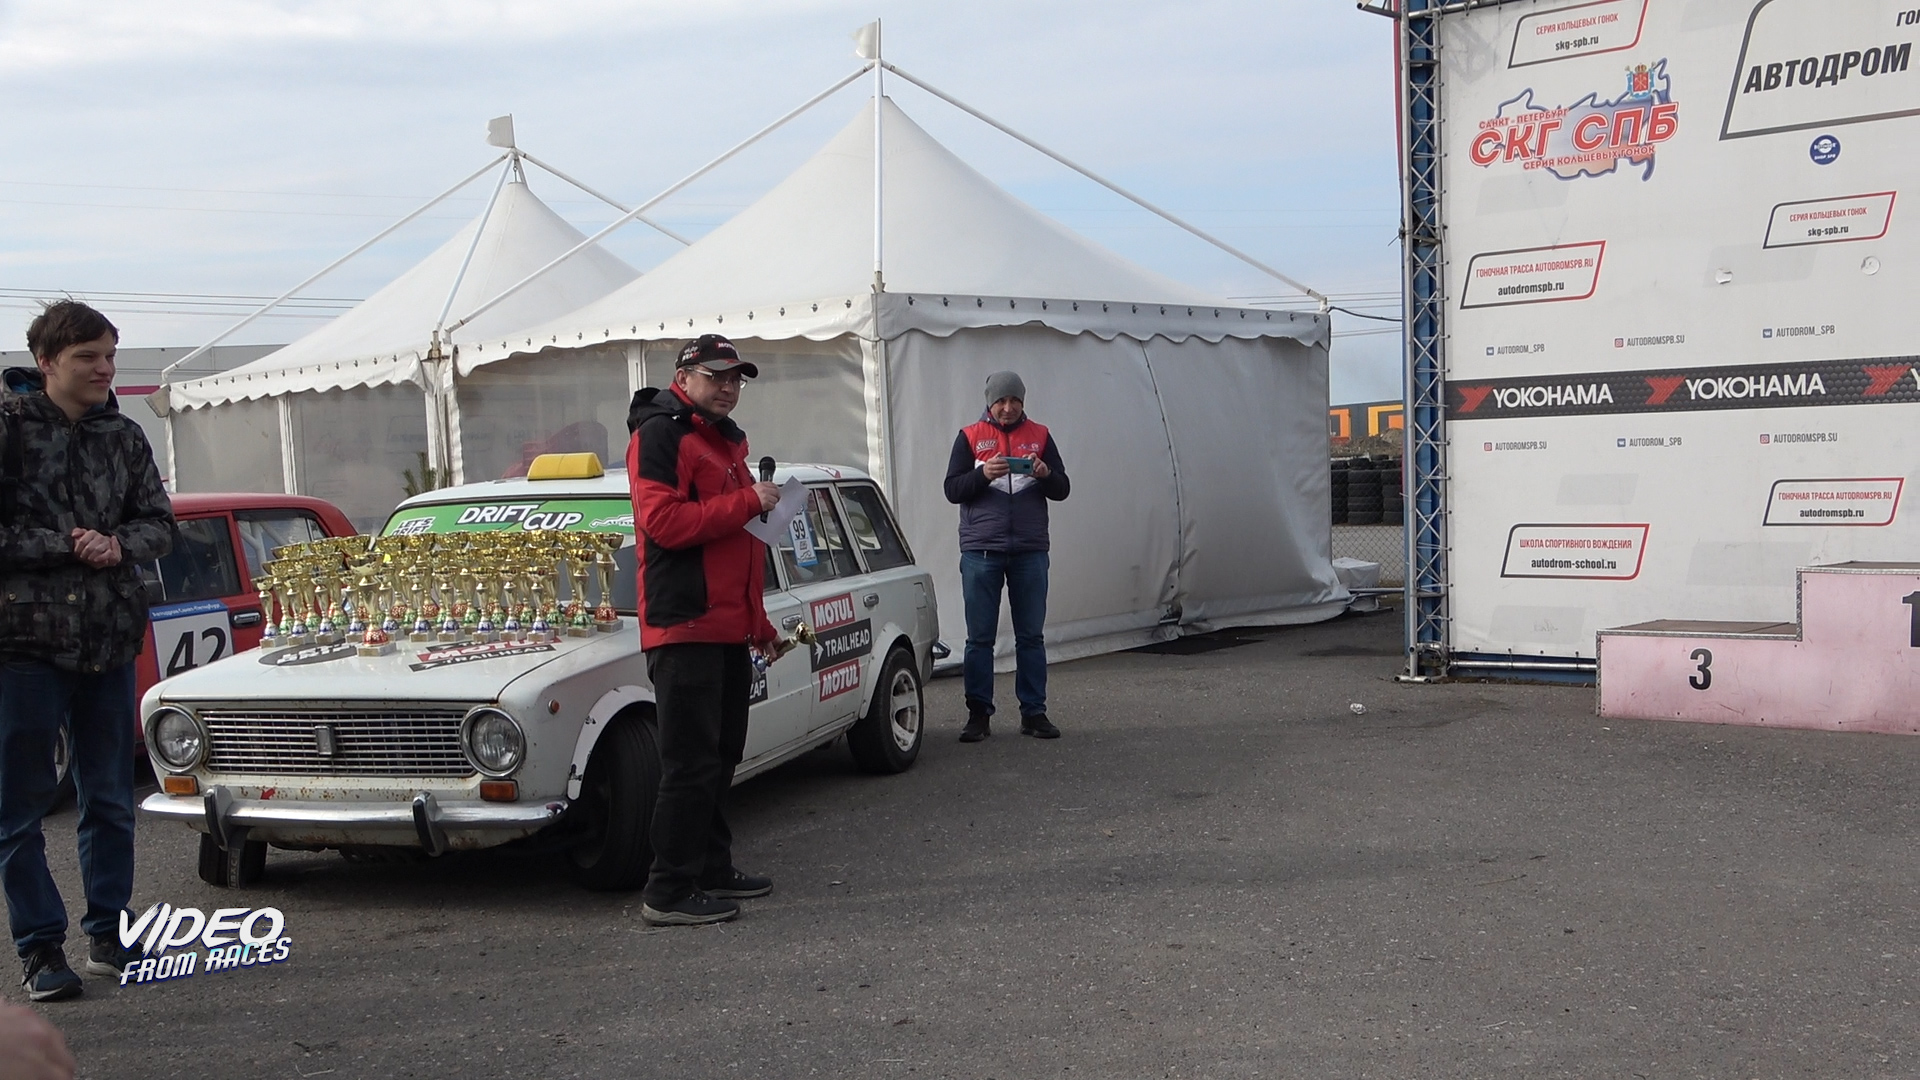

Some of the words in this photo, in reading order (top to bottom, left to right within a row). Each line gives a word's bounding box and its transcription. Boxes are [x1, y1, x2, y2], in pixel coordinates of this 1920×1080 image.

[1536, 24, 1556, 36] СЕРИЯ
[1557, 16, 1597, 32] КОЛЬЦЕВЫХ
[1598, 13, 1619, 25] ГОНОК
[1555, 36, 1599, 51] skg-spb.ru
[1743, 43, 1912, 94] АВТОДРОМ
[1470, 119, 1562, 167] СКГ
[1572, 101, 1680, 152] СПБ
[1523, 158, 1555, 171] СЕРИЯ
[1557, 151, 1618, 166] КОЛЬЦЕВЫХ
[1621, 145, 1655, 158] ГОНОК
[1789, 213, 1809, 222] СЕРИЯ
[1809, 209, 1847, 220] КОЛЬЦЕВЫХ
[1847, 207, 1867, 216] ГОНОК
[1808, 225, 1849, 237] skg-spb.ru
[1476, 267, 1509, 278] ГОНОЧНАЯ
[1510, 264, 1534, 275] ТРАССА
[1535, 258, 1594, 272] AUTODROMSPB.RU
[1498, 281, 1565, 296] autodromspb.ru
[1776, 325, 1835, 338] AUTODROM_SPB
[1627, 334, 1685, 347] AUTODROMSPB.SU
[1497, 344, 1545, 356] AUTODROM_SPB
[1685, 372, 1826, 400] YOKOHAMA
[1493, 383, 1614, 409] YOKOHAMA
[1629, 437, 1682, 448] AUTODROM_SPB
[1773, 432, 1838, 444] AUTODROMSPB.SU
[1495, 441, 1547, 451] AUTODROMSPB.SU
[1778, 492, 1810, 501] ГОНОЧНАЯ
[1811, 492, 1835, 500] ТРАССА
[1836, 491, 1893, 500] AUTODROMSPB.RU
[457, 504, 539, 524] DRIFT
[523, 512, 582, 531] CUP
[1800, 508, 1864, 519] autodromspb.ru
[1520, 539, 1545, 548] ШКОЛА
[1545, 539, 1591, 549] СПОРТИВНОГО
[1592, 540, 1632, 550] ВОЖДЕНИЯ
[1531, 558, 1617, 570] autodrom-school.ru
[814, 597, 853, 628] MOTUL
[825, 629, 870, 657] TRAILHEAD
[166, 627, 226, 678] 42
[1689, 648, 1713, 690] 3
[821, 665, 858, 698] MOTUL
